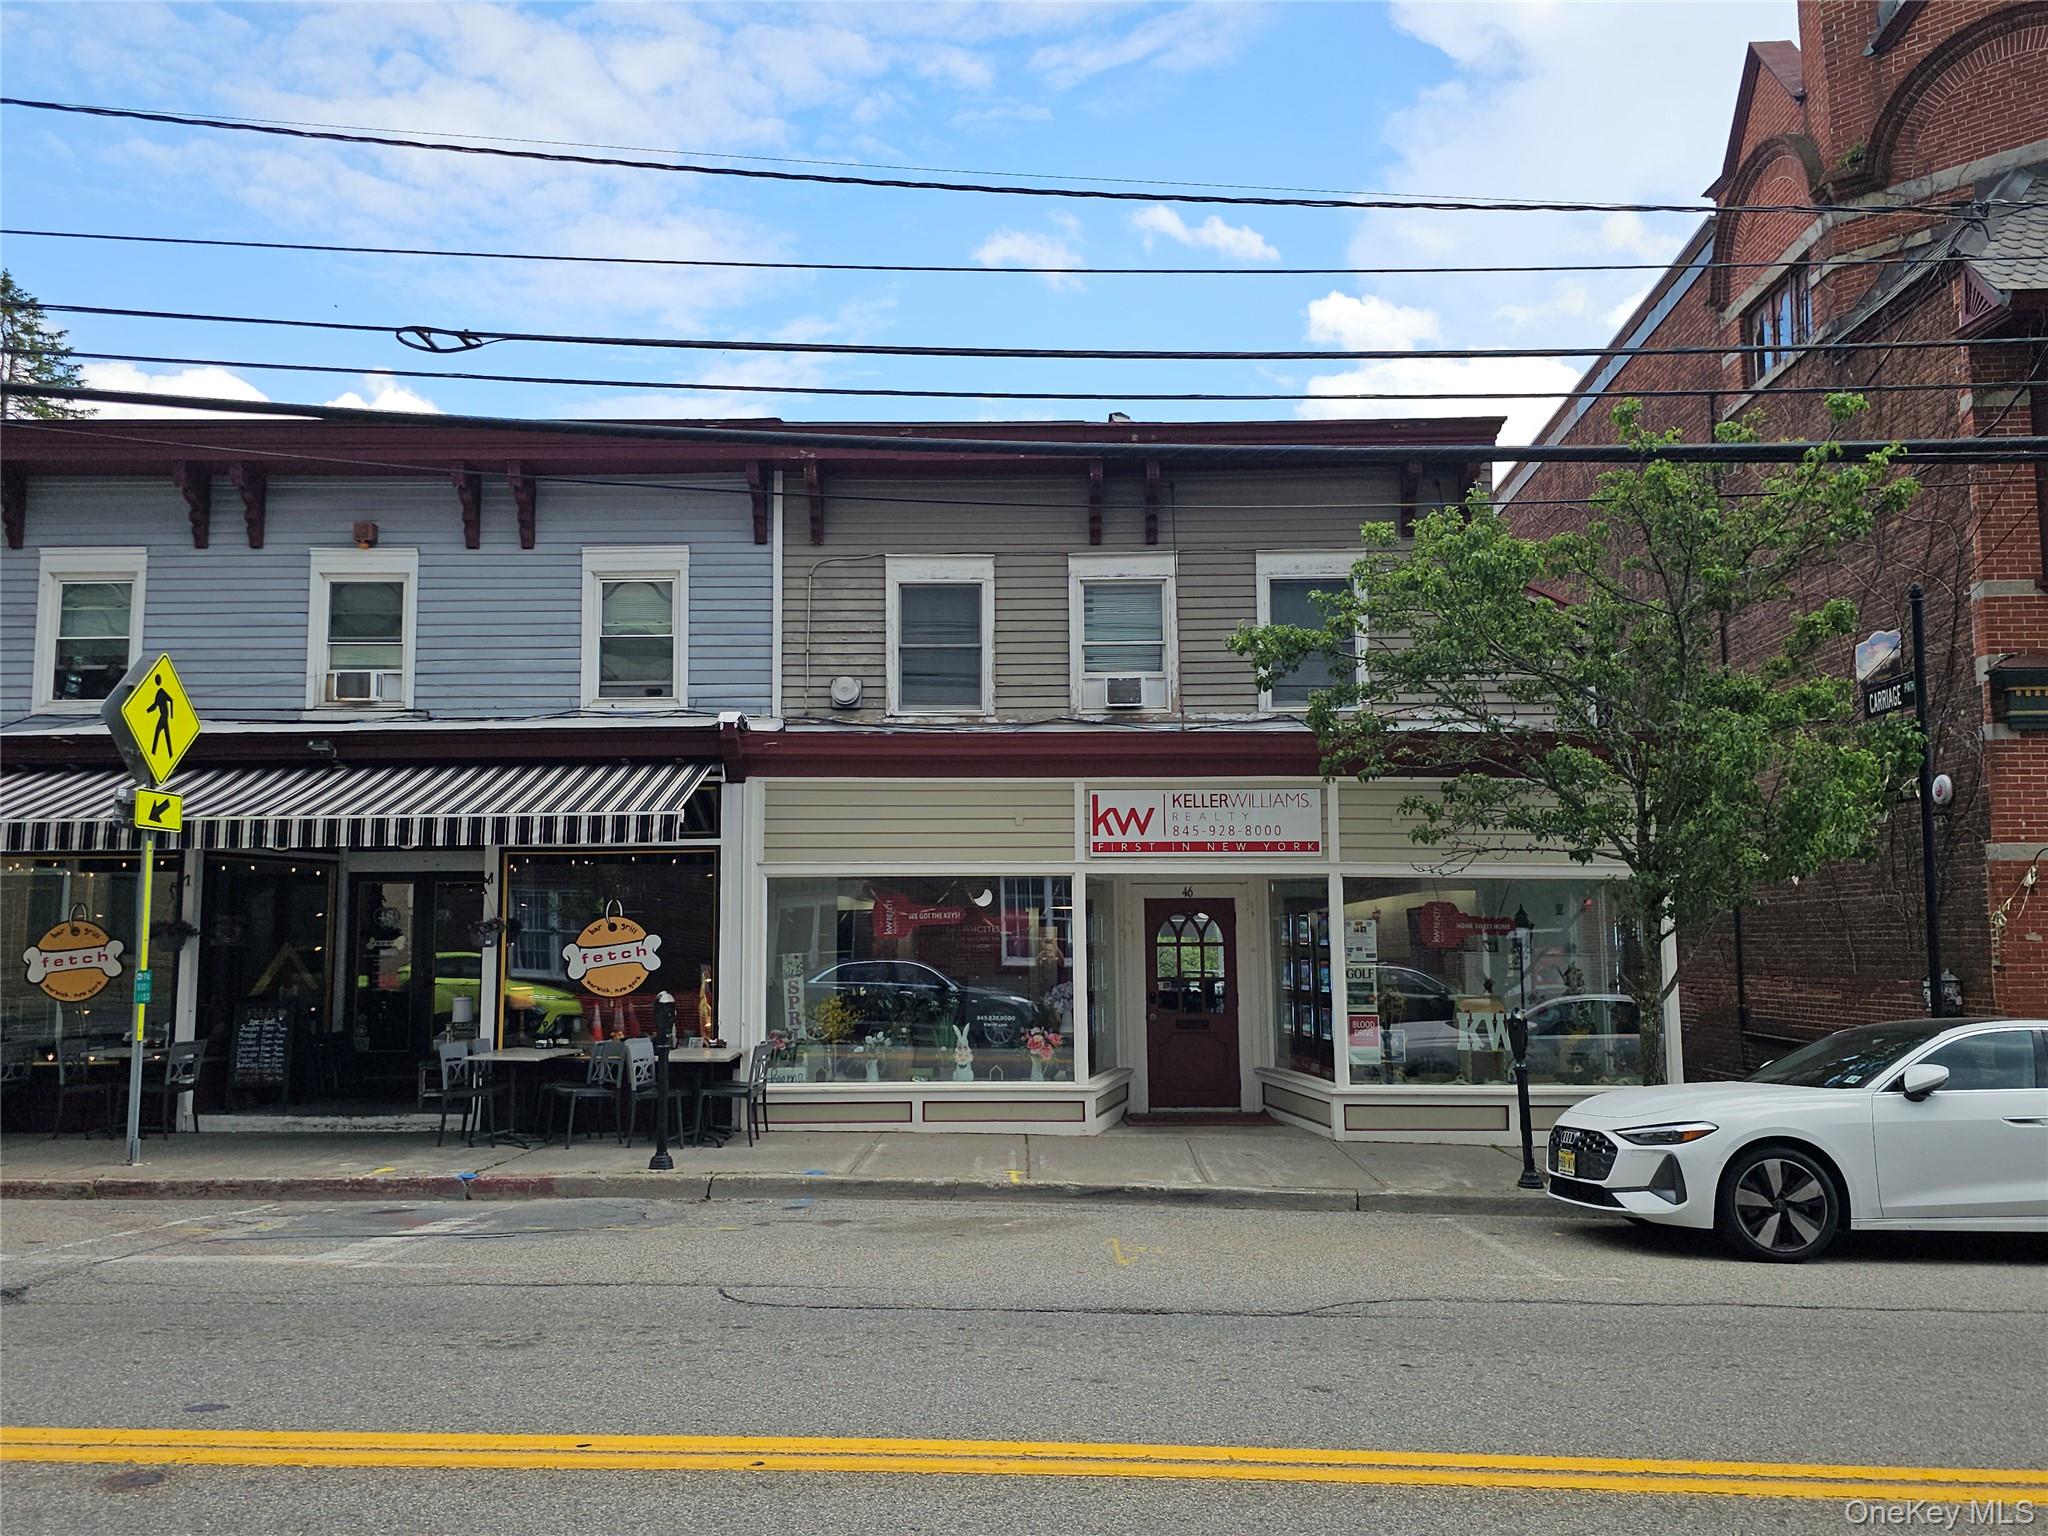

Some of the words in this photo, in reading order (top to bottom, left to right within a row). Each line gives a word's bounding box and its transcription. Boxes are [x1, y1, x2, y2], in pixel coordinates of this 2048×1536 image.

[1869, 685, 1902, 713] CARRIAGE
[1092, 794, 1155, 837] kw
[1172, 811, 1249, 822] REALTY
[1172, 825, 1281, 837] 845-928-8000
[1098, 842, 1155, 852] FIRST
[1172, 842, 1190, 851] IN
[1207, 842, 1247, 851] NEW
[1264, 842, 1315, 851] YORK
[1182, 886, 1193, 898] 46
[587, 924, 602, 935] bar
[620, 923, 638, 934] grill
[42, 952, 108, 968] fetch
[581, 946, 647, 964] fetch
[1346, 968, 1374, 979] GOLF
[1352, 1020, 1375, 1029] BLOOD
[1354, 1028, 1374, 1037] DRIVE
[1456, 1012, 1512, 1051] KW
